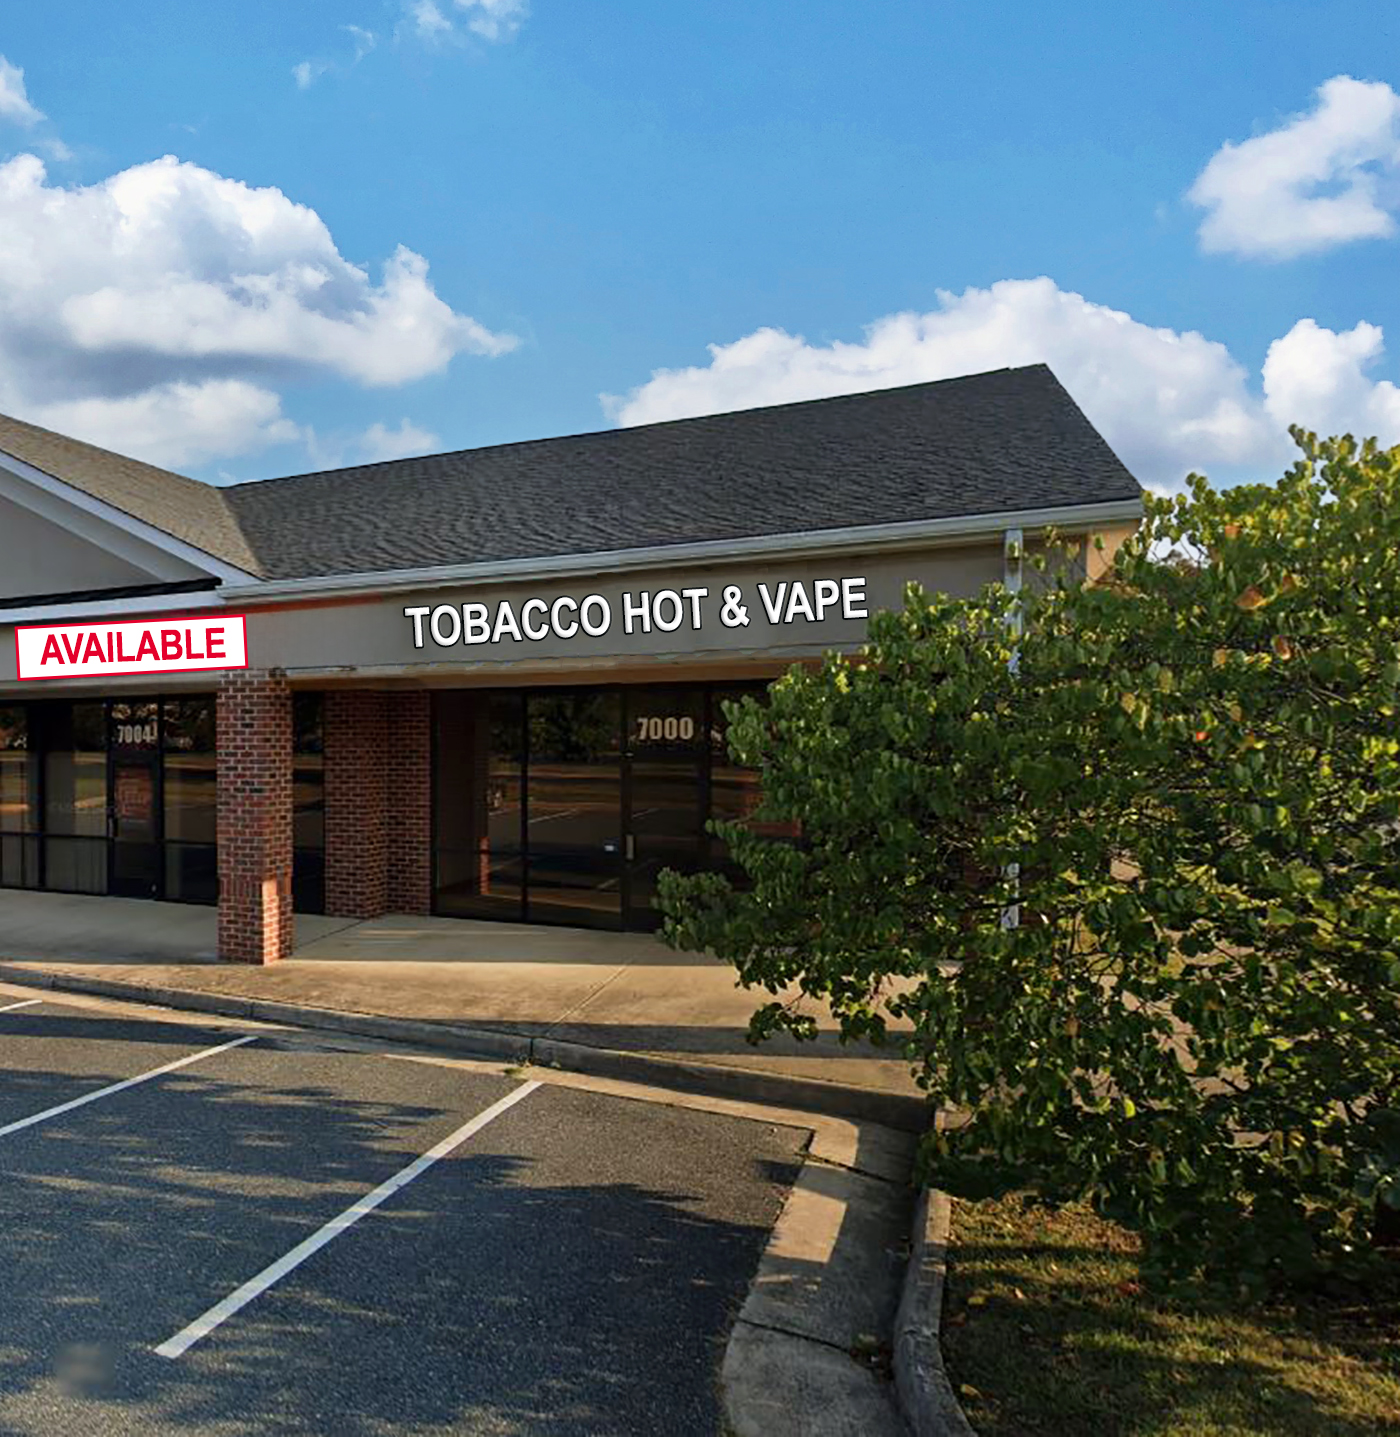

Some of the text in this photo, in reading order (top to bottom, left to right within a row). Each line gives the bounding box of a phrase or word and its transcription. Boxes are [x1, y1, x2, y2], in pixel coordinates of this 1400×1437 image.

[404, 577, 868, 649] TOBACCO HOT & VAPE
[39, 626, 227, 666] AVAILABLE
[636, 716, 694, 741] 7000
